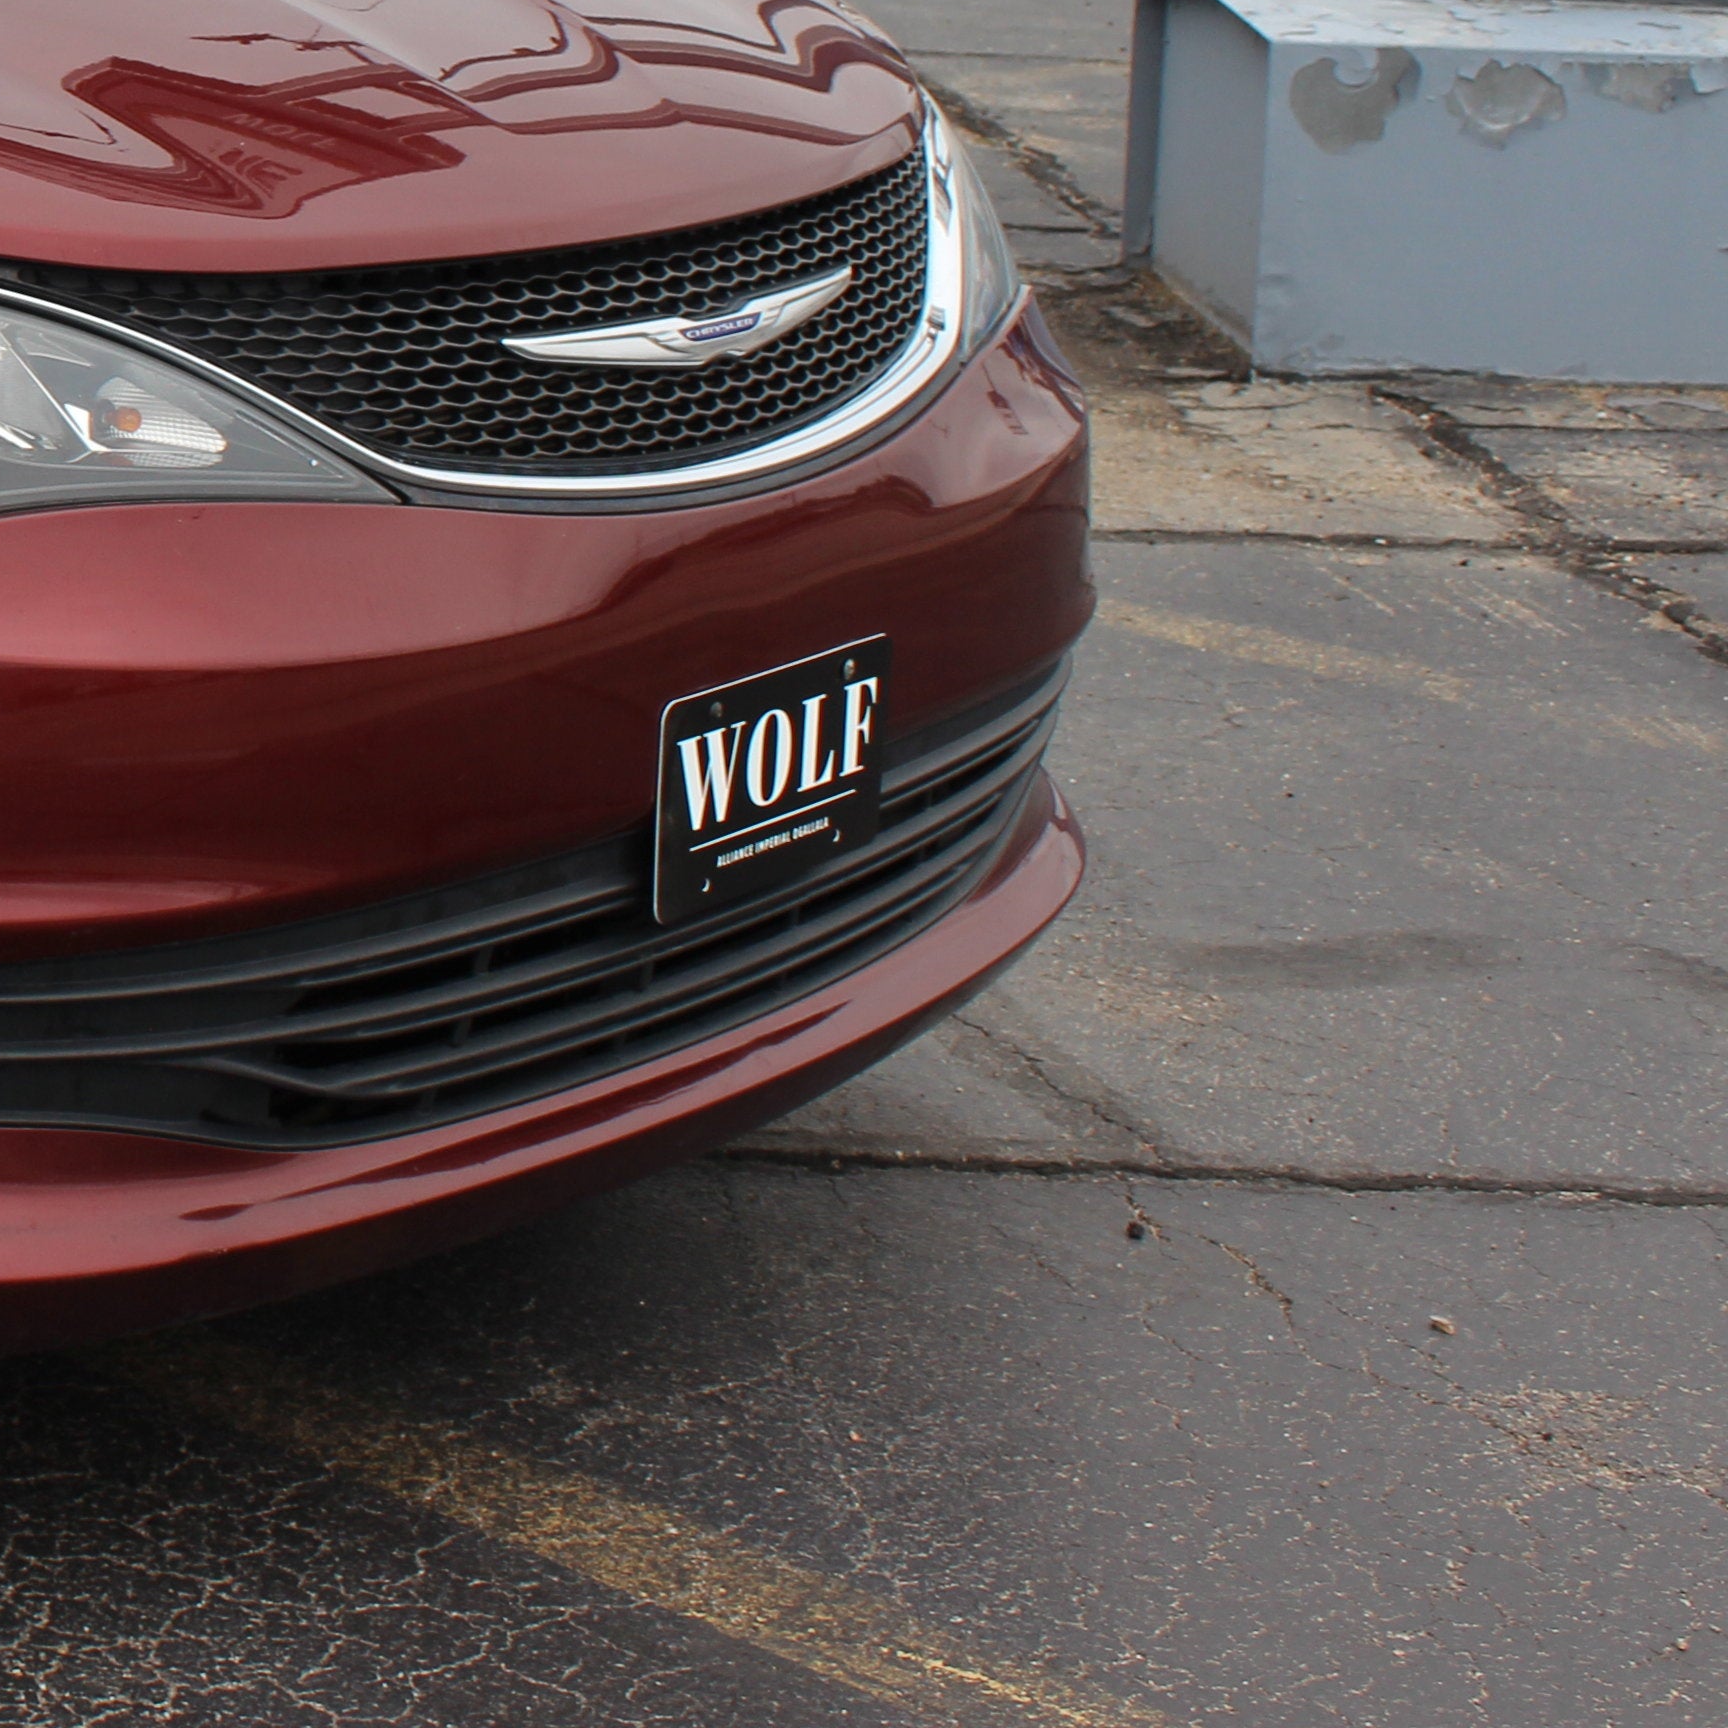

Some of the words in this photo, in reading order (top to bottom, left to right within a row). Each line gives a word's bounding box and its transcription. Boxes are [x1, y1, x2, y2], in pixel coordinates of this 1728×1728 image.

[685, 317, 754, 339] CHRYSLER
[677, 676, 878, 832] WOLF
[716, 843, 755, 868] ALLIANCE
